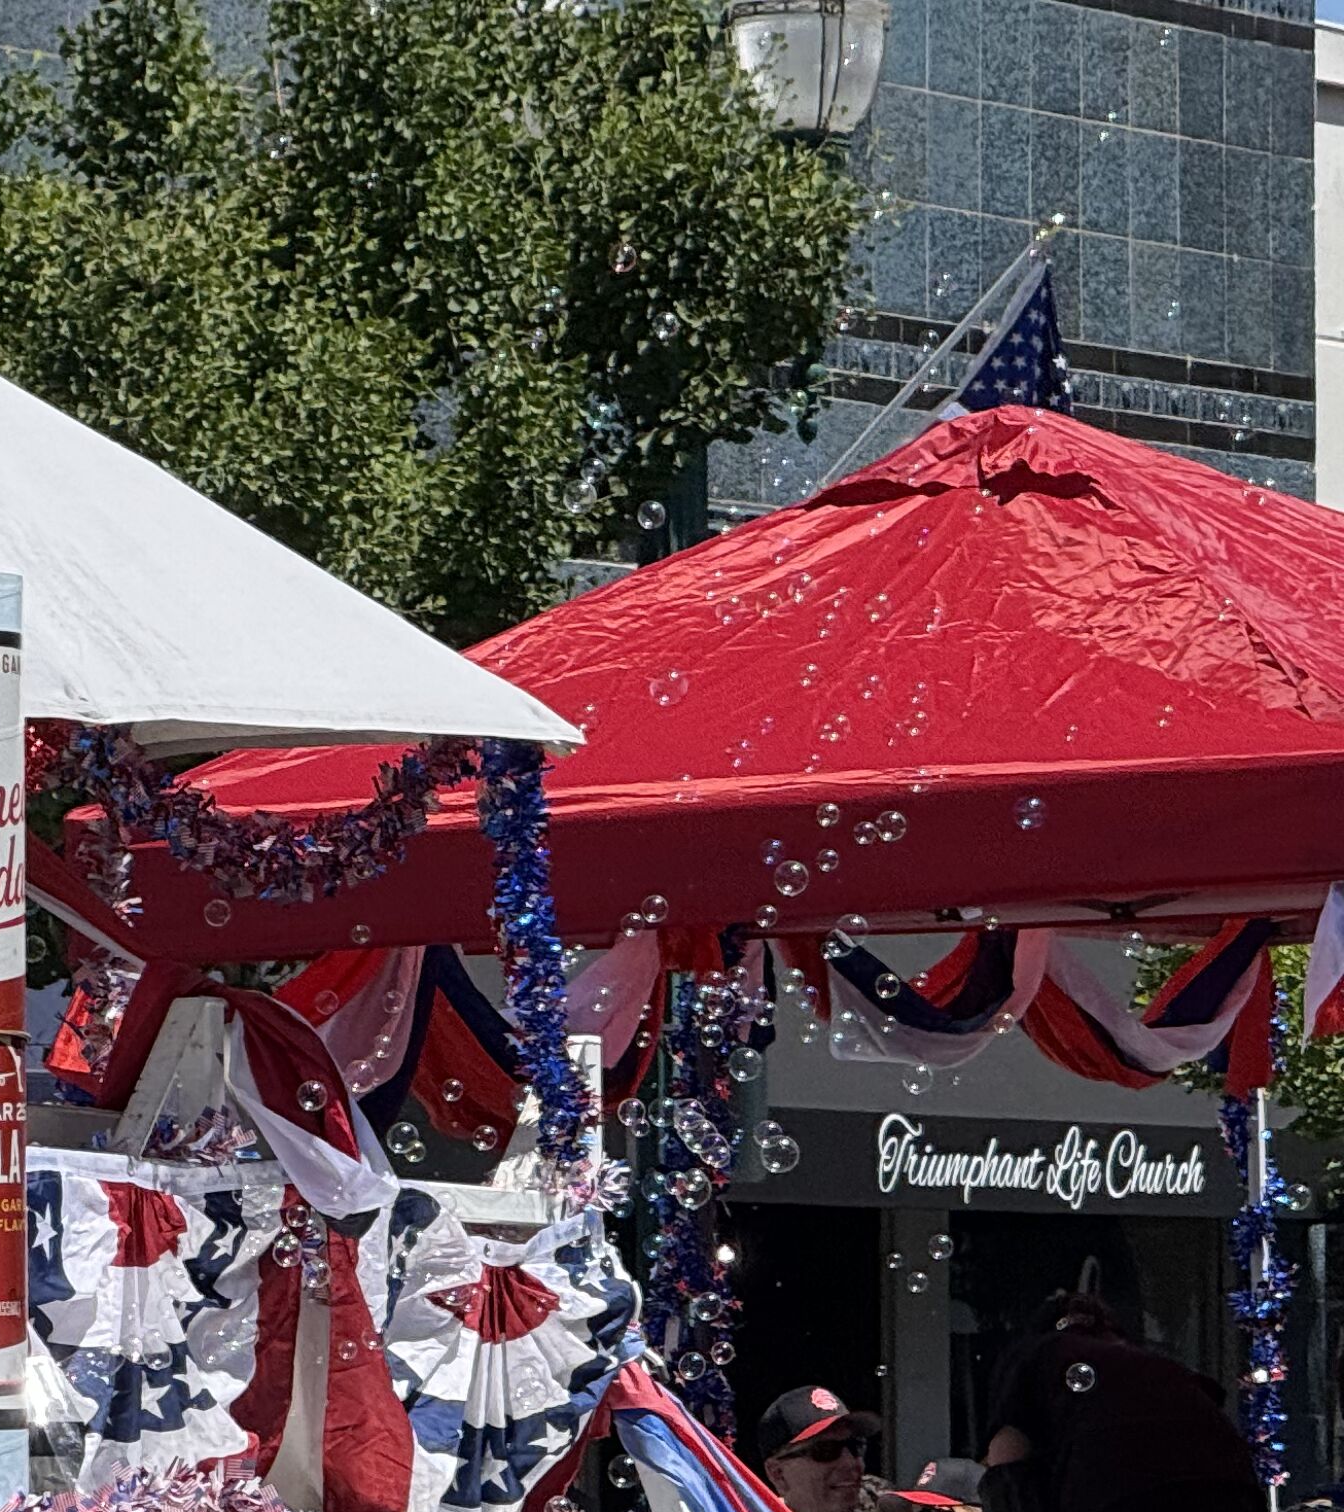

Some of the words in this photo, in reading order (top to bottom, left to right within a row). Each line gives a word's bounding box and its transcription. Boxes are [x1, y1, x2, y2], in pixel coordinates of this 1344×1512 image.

[877, 1113, 1044, 1205] Triumphant
[1045, 1124, 1103, 1211] Life
[1105, 1130, 1206, 1200] Church
